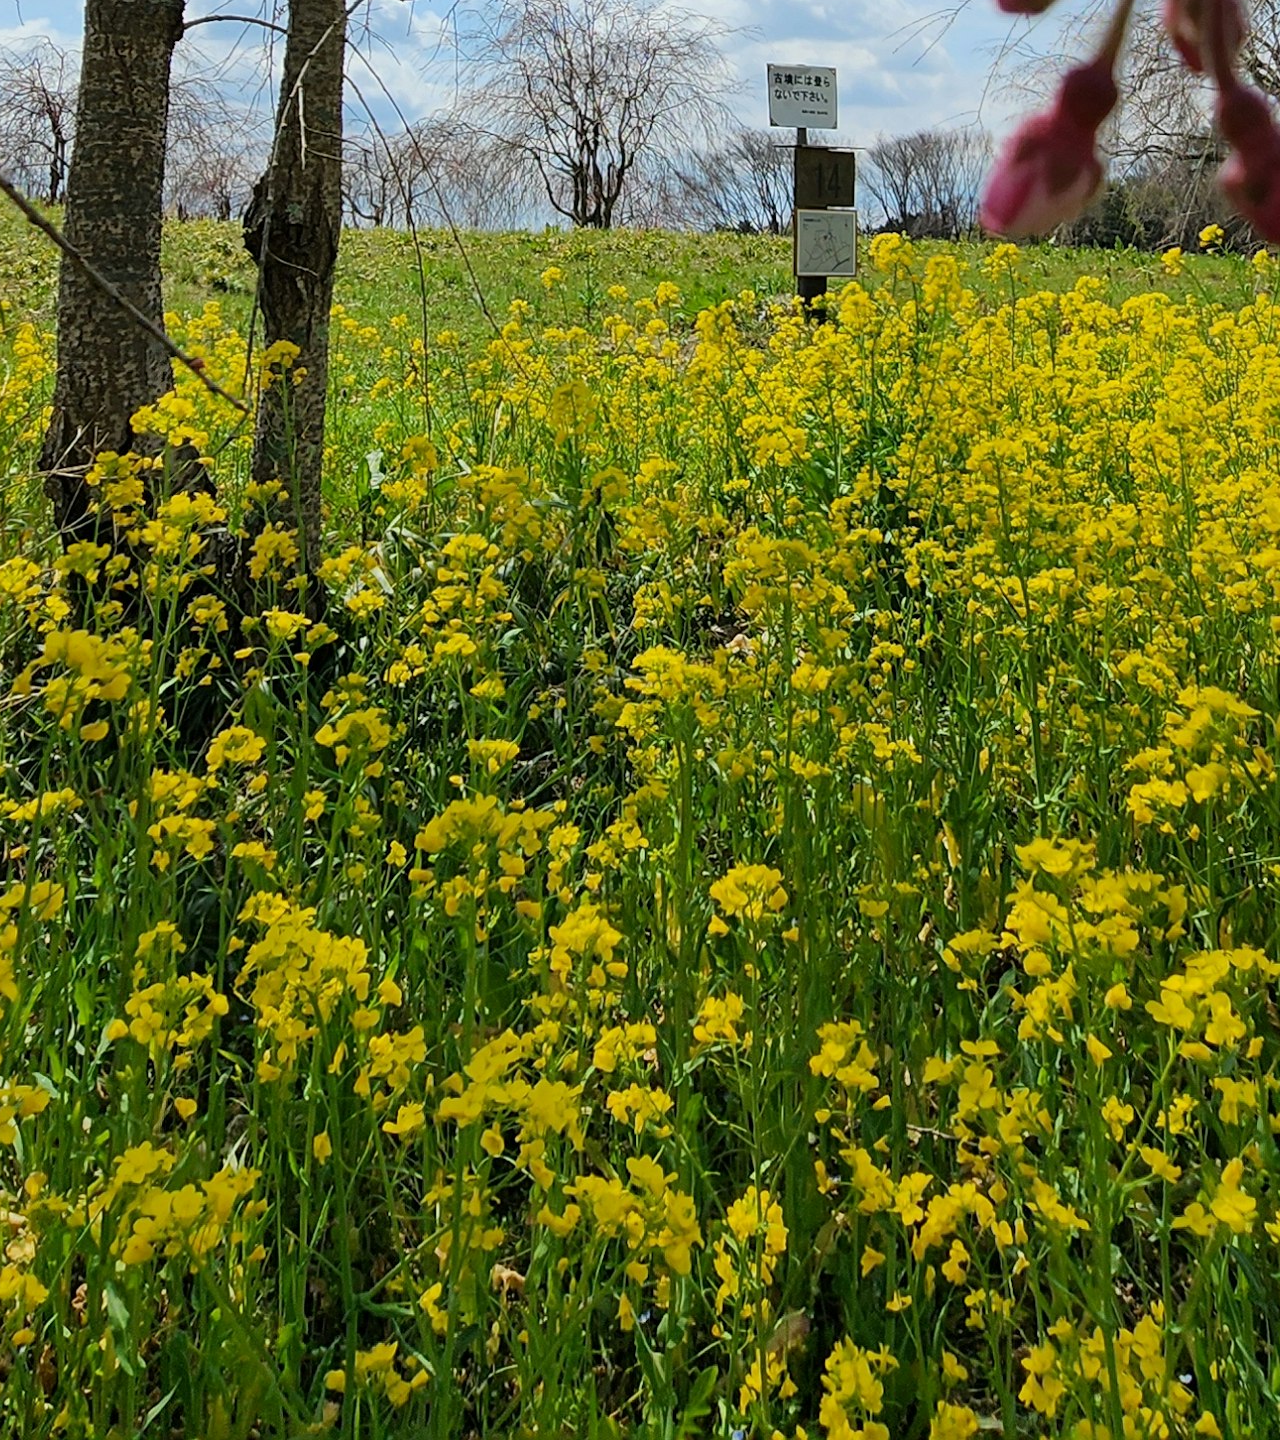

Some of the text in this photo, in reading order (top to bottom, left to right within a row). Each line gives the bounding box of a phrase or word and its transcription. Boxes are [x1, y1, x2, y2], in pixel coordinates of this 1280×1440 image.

[774, 72, 830, 87] 古墳には登ら
[774, 89, 828, 103] ないで下さい。
[816, 163, 841, 198] 14
